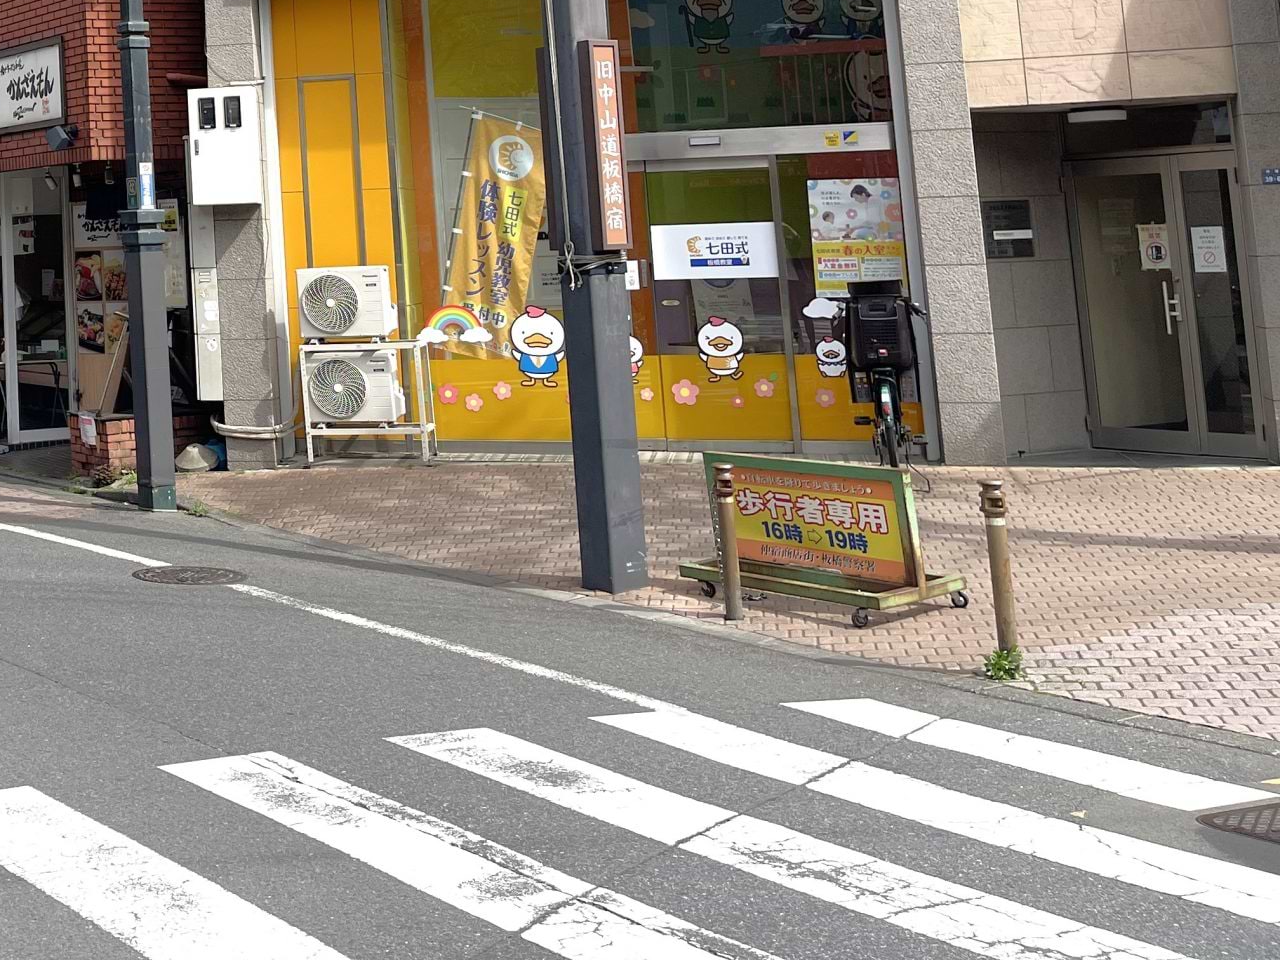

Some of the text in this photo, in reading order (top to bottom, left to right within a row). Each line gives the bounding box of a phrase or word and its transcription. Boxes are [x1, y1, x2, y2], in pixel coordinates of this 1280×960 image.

[595, 60, 624, 230] 旧中山道板橋宿
[466, 178, 501, 297] 体験レッスン
[489, 190, 523, 306] 七田式 幼児教室
[705, 241, 749, 255] 七田式
[736, 487, 889, 535] 歩行者専用
[762, 520, 868, 554] 16時 19時
